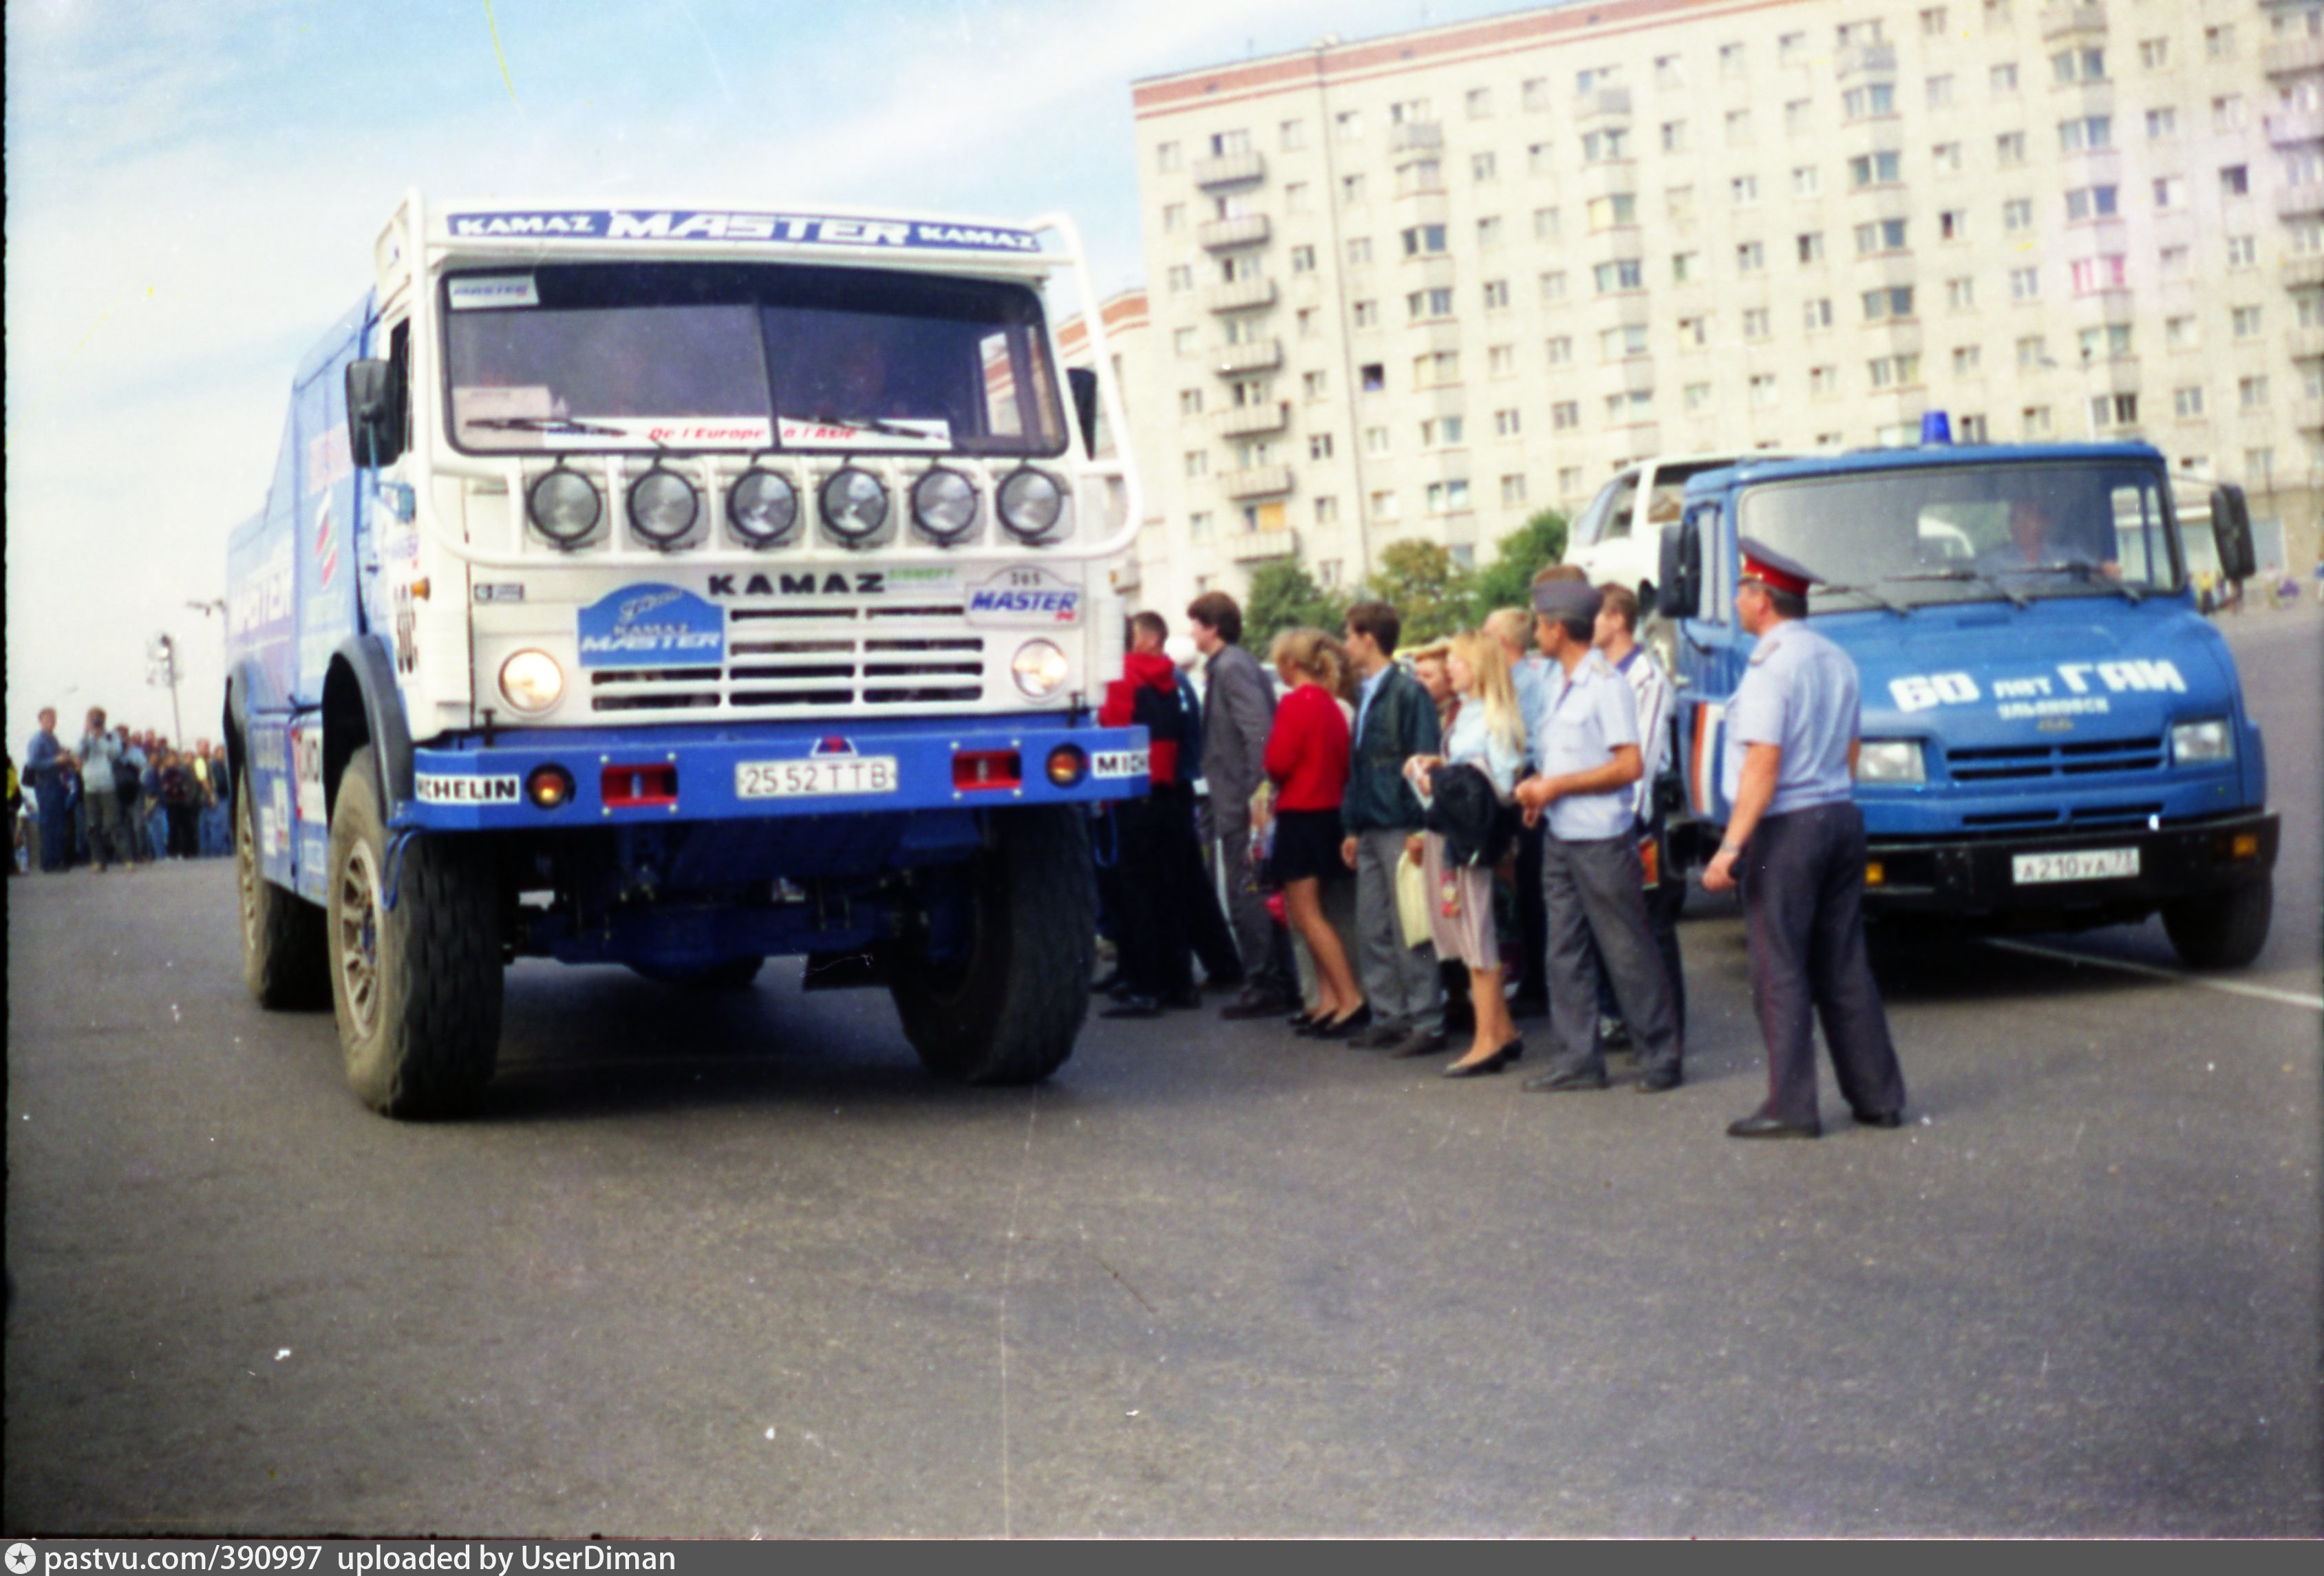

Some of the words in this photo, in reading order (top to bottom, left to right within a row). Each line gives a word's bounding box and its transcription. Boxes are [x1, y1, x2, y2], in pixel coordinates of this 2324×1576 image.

[456, 215, 594, 235] KAMAZ
[607, 211, 910, 246] MASTER
[916, 225, 1033, 248] KAMAZ
[708, 572, 885, 595] KAMAZ
[970, 590, 1078, 611] MASTER
[582, 632, 721, 651] MASTER
[1888, 671, 1981, 713] 60
[2056, 659, 2188, 694] ГАИ
